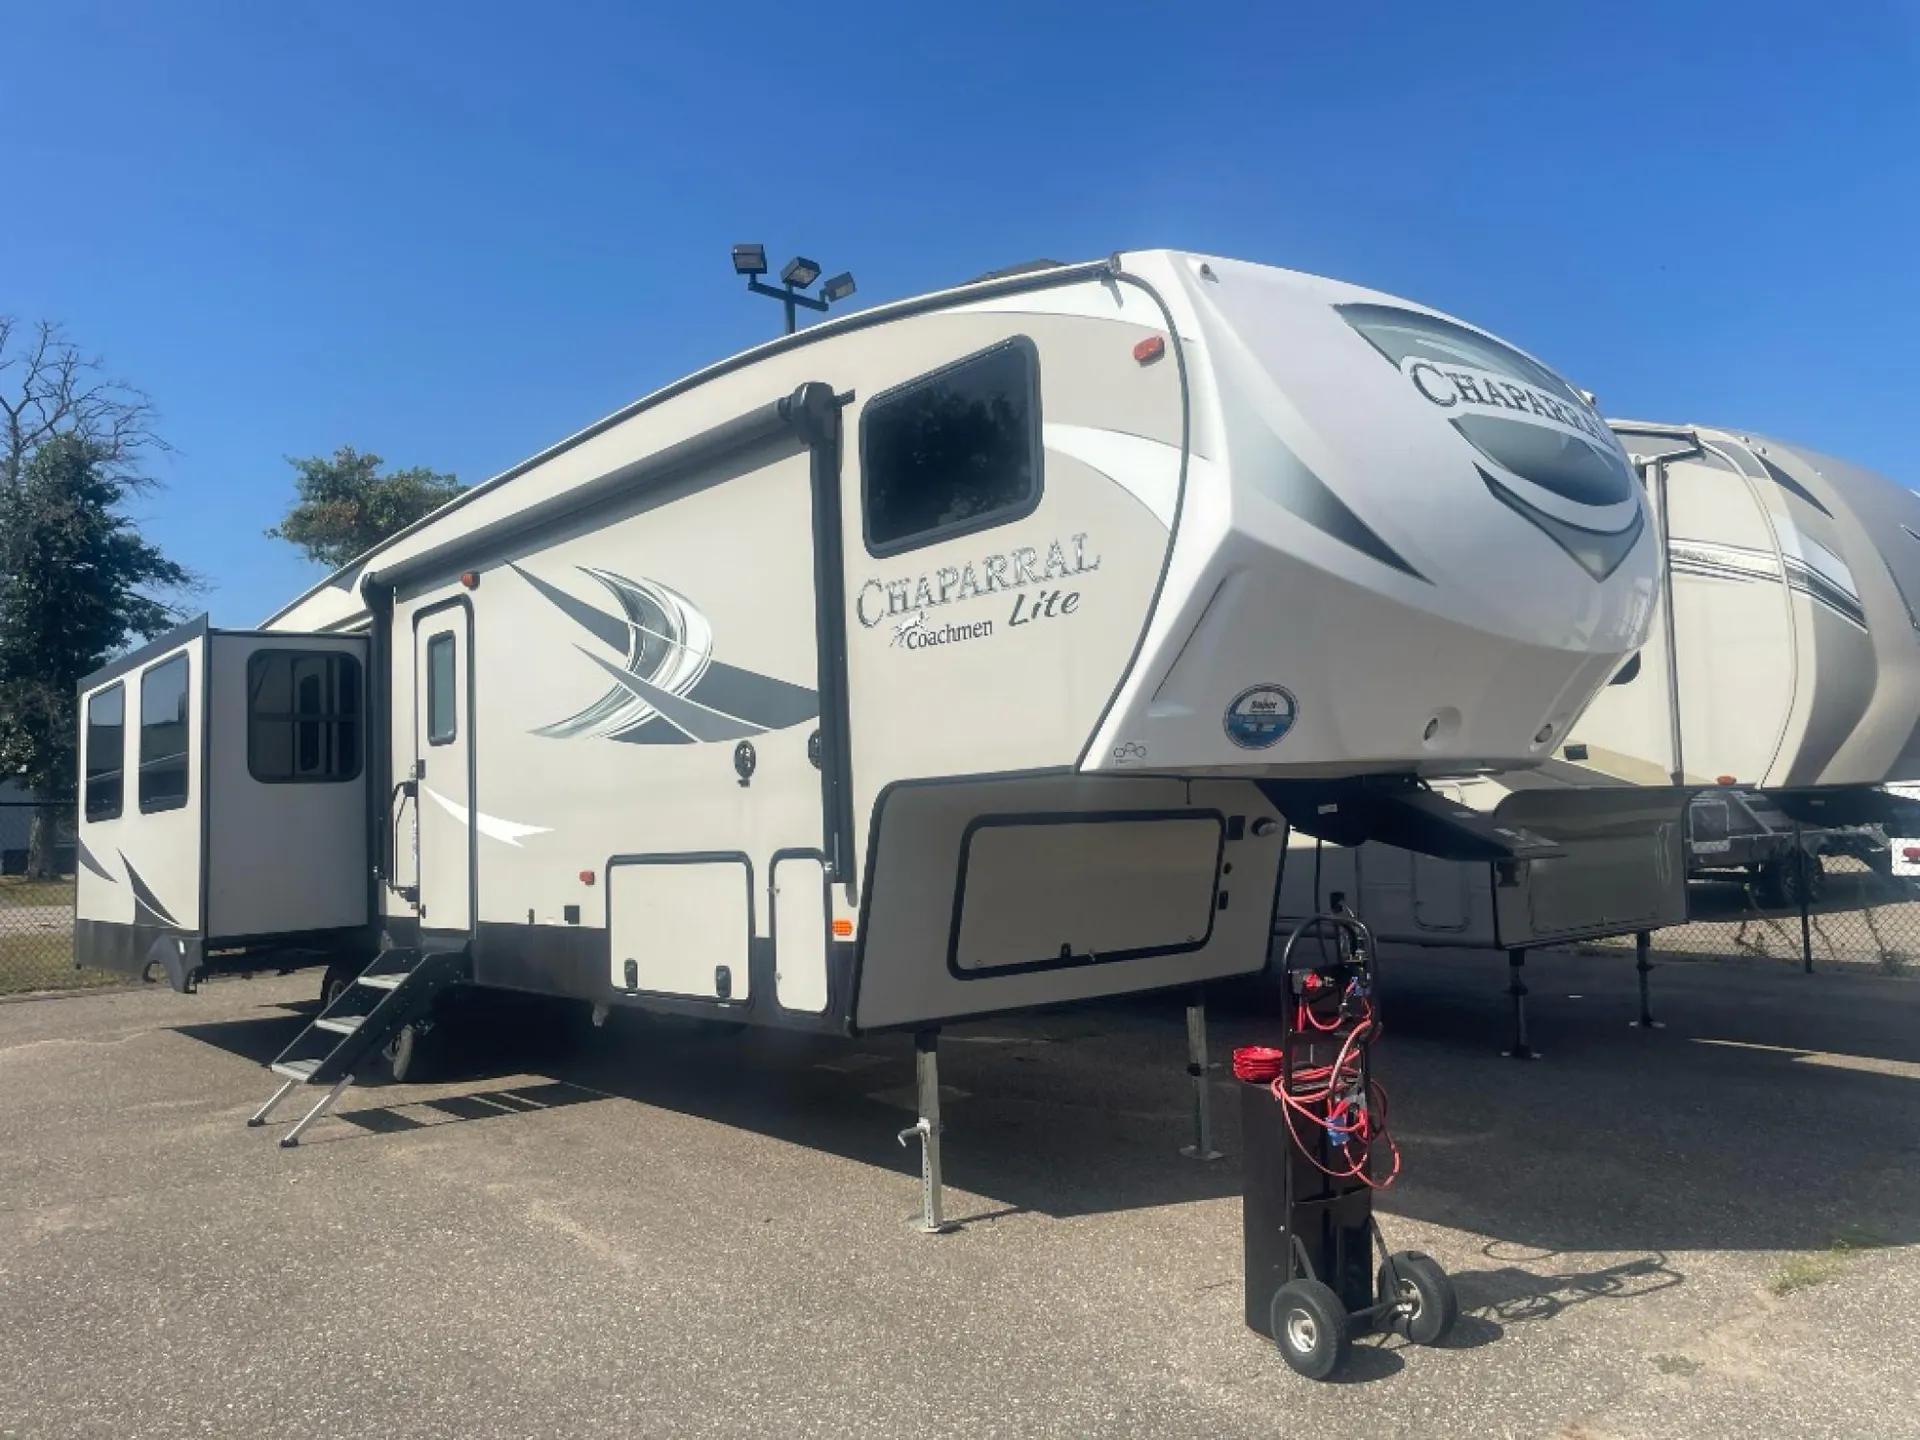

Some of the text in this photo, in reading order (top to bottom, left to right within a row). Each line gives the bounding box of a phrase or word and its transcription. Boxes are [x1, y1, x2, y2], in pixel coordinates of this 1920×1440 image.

[856, 532, 1101, 628] CHAPARRAL
[1008, 590, 1081, 627] Lite
[906, 619, 994, 650] Coachmen
